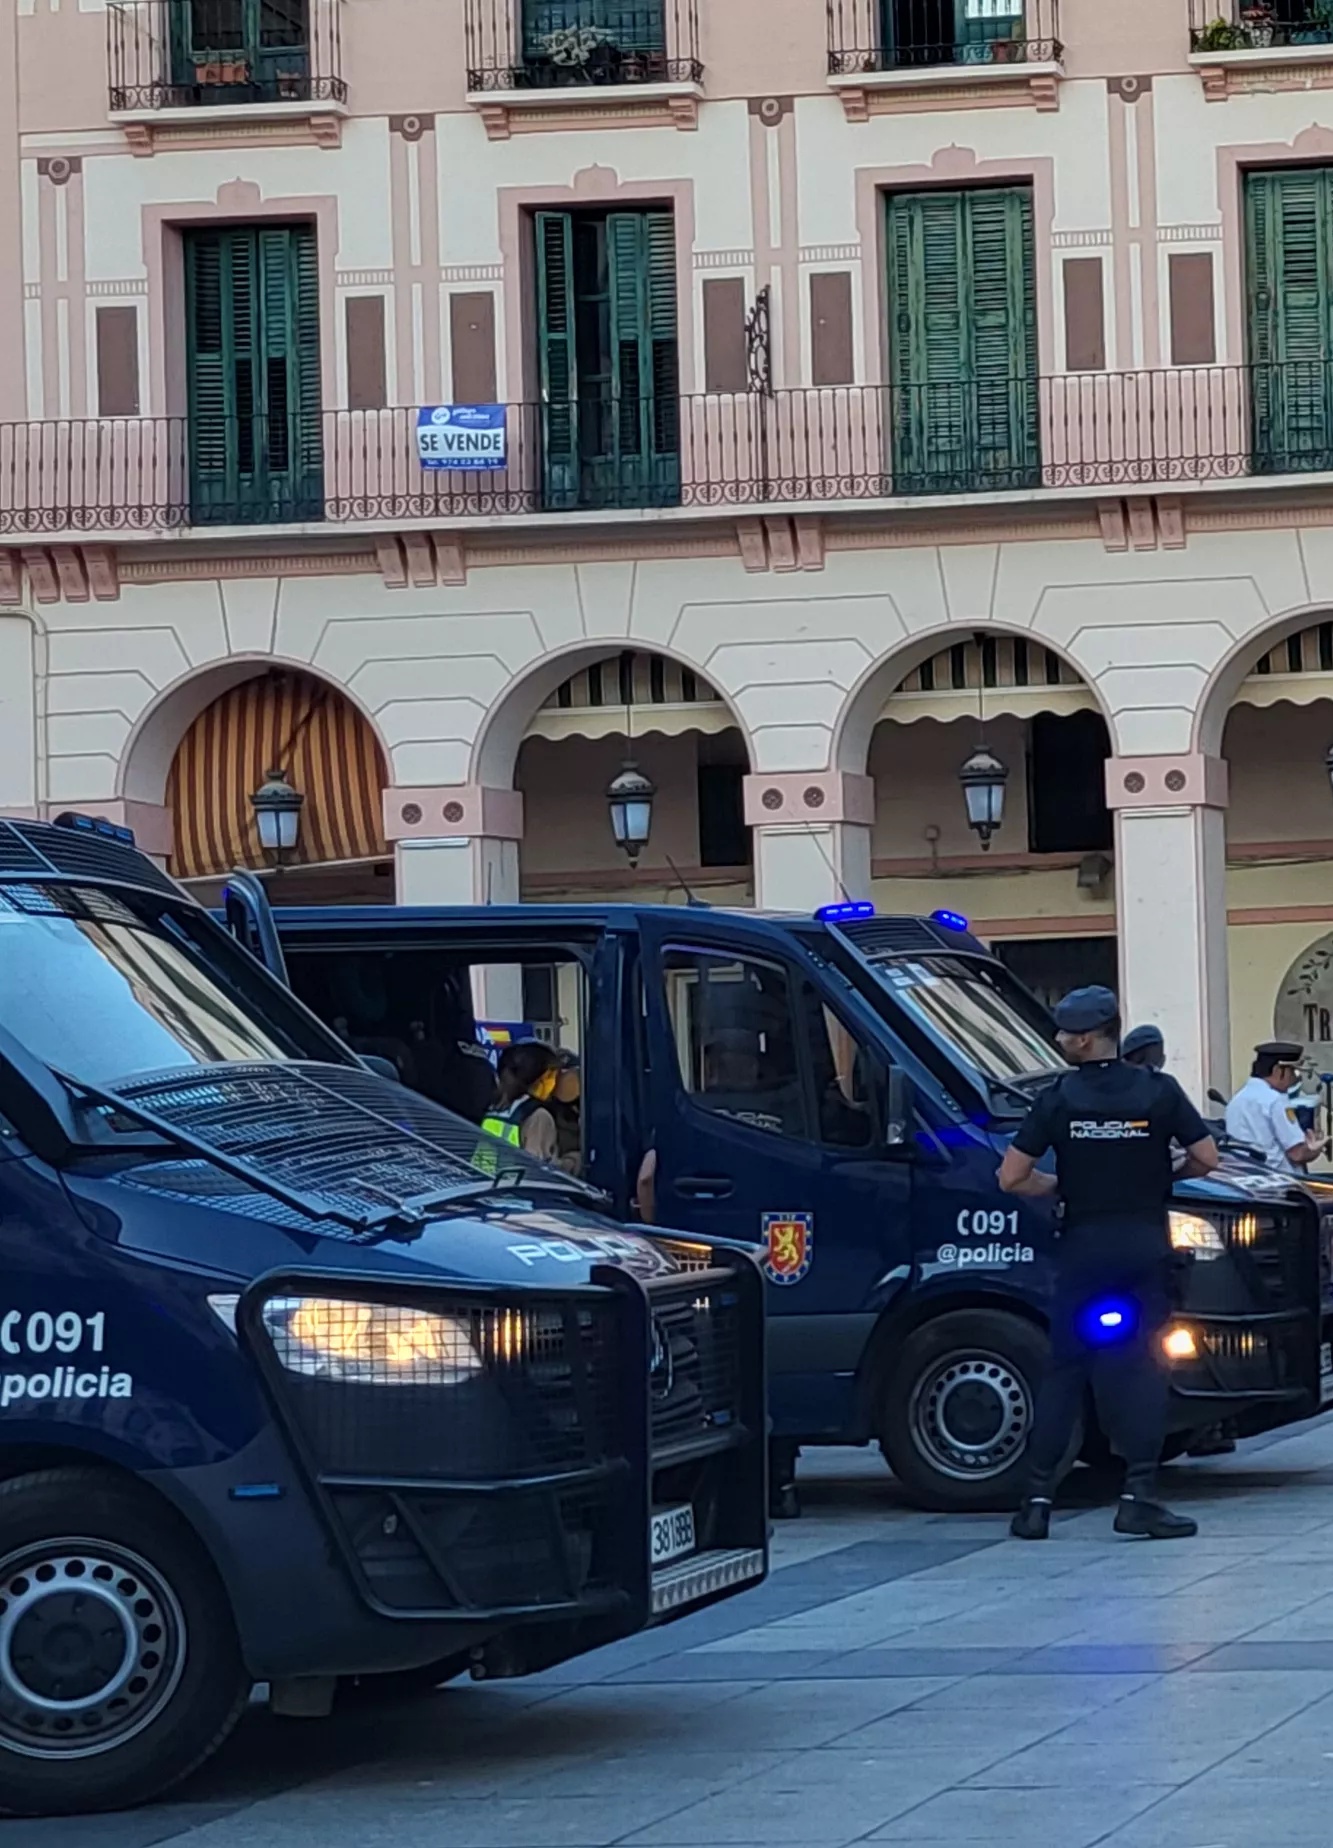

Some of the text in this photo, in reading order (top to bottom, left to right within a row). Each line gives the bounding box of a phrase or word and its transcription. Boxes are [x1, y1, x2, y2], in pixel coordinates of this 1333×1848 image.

[420, 433, 501, 451] SE VENDE
[1070, 1121, 1133, 1130] POLICIA
[1070, 1130, 1150, 1139] NACIONAL
[972, 1209, 1019, 1236] 091
[937, 1242, 1035, 1268] @policia
[26, 1310, 105, 1353] 091
[0, 1365, 133, 1407] policia
